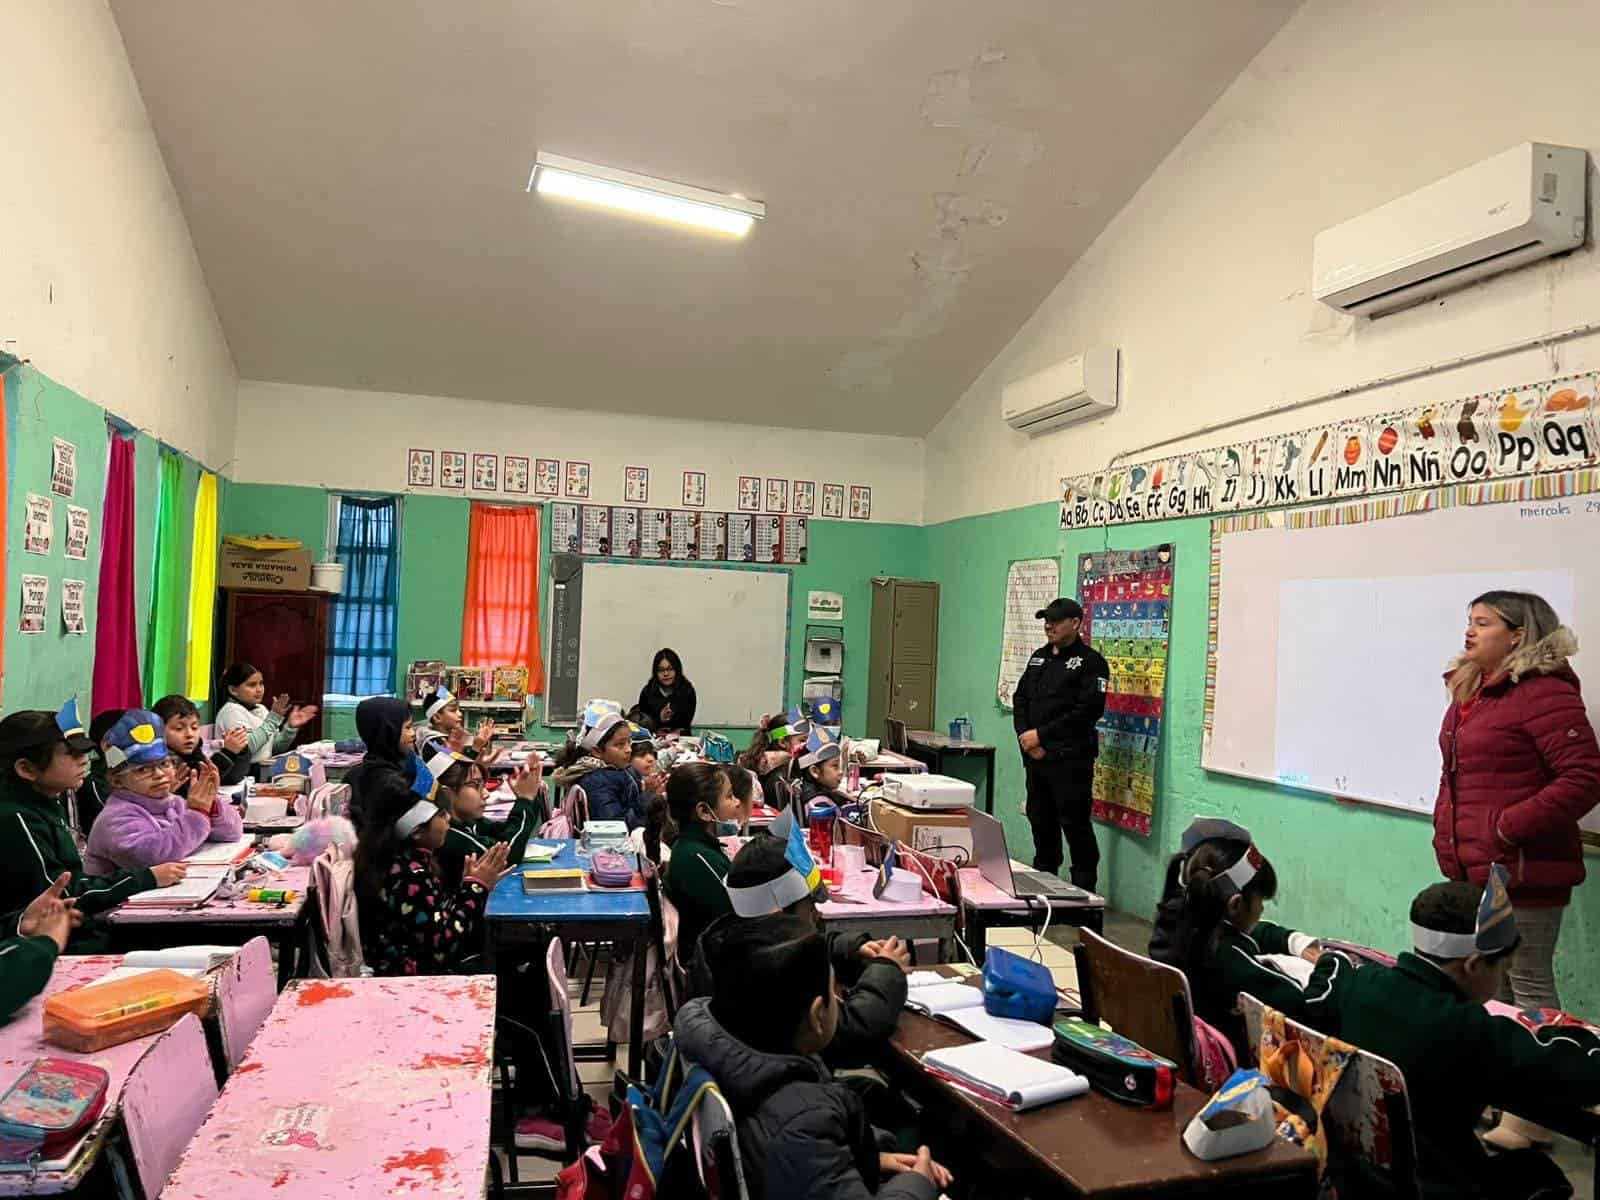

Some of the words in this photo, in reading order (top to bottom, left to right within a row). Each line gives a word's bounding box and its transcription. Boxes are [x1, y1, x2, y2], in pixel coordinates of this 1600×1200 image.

[412, 452, 430, 465] Aa
[444, 454, 463, 467] Bb
[476, 455, 494, 468] Cc
[537, 461, 556, 474] Dd
[1075, 505, 1088, 524] Bb
[1093, 502, 1104, 522] Cc
[1110, 499, 1123, 521] Dd
[1126, 497, 1140, 518] Ee
[1147, 493, 1161, 517] Ff
[1169, 486, 1186, 513] Gg
[1193, 486, 1210, 510] Hh
[1248, 473, 1266, 505] Jj
[1275, 474, 1297, 501] Kk
[1336, 466, 1366, 490] Mm
[1373, 458, 1401, 488] Nn
[1410, 449, 1441, 483] Ññ
[1450, 446, 1487, 478] Oo
[1498, 432, 1535, 471] Pp
[1543, 421, 1589, 460] Qq
[571, 508, 577, 520] 1
[599, 512, 606, 523] 2
[627, 513, 634, 524] 3
[657, 512, 664, 524] 4
[687, 515, 695, 527] 5
[717, 517, 725, 528] 6
[744, 519, 750, 531] 7
[771, 518, 779, 529] 8
[797, 518, 805, 529] 9
